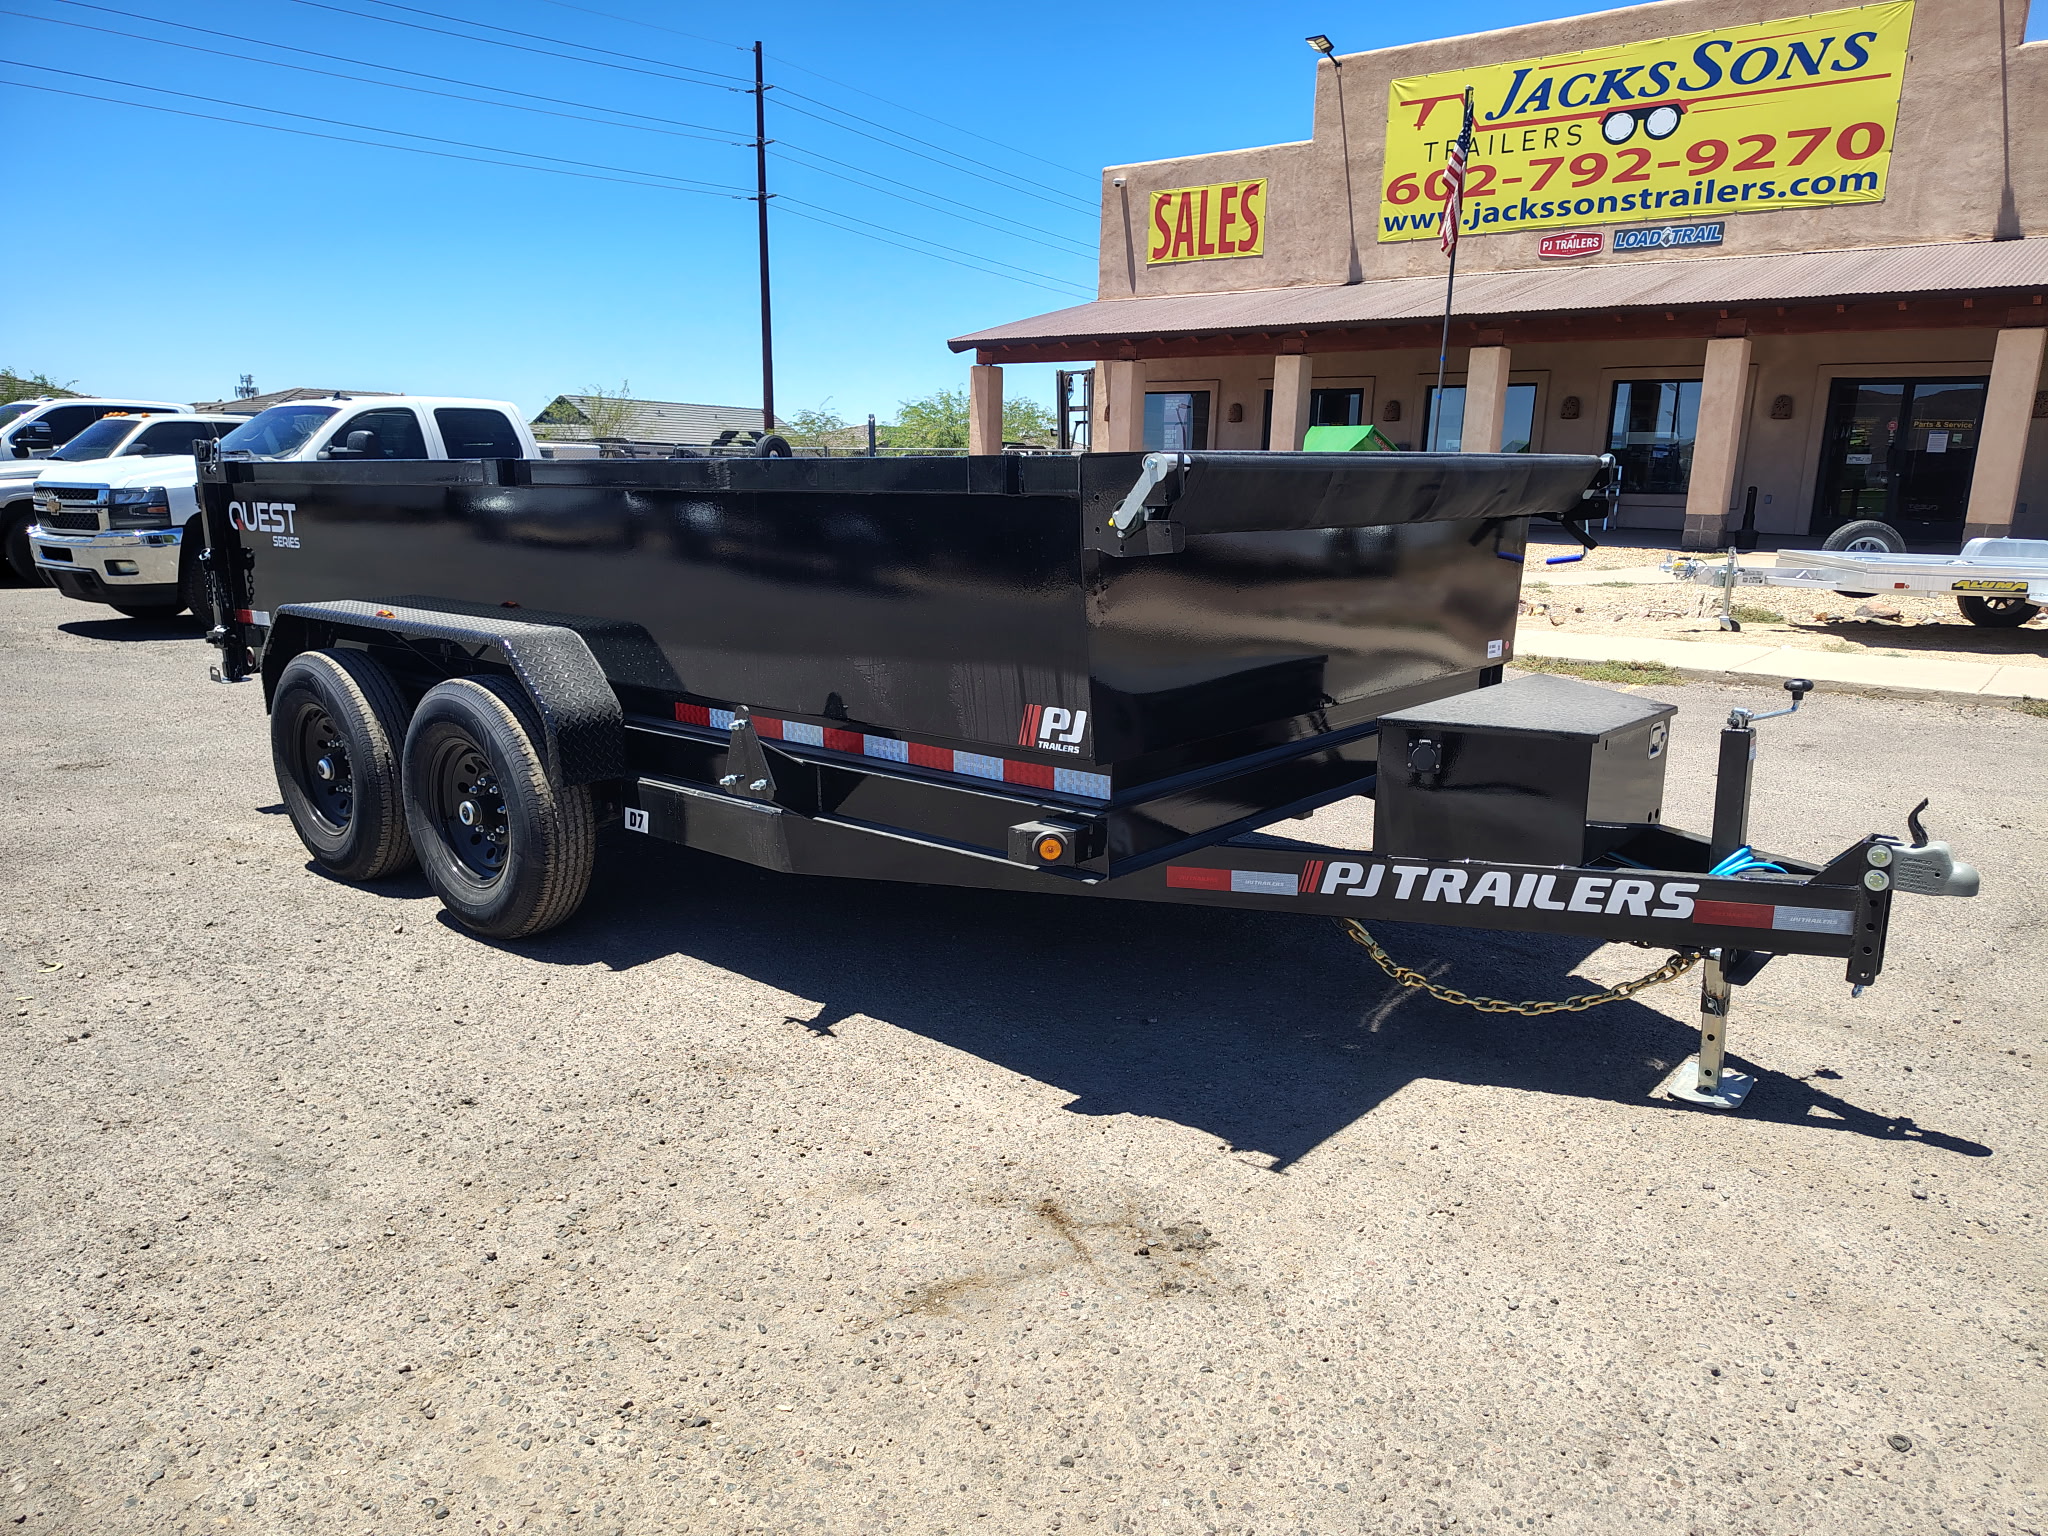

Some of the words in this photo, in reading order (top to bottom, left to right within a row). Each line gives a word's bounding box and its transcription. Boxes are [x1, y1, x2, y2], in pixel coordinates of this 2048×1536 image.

[1424, 124, 1583, 162] TRAILERS
[1386, 122, 1886, 205] 602-792-9270
[1152, 183, 1260, 260] SALES
[1542, 240, 1552, 251] PJ
[1555, 237, 1600, 250] TRAILERS
[1614, 230, 1662, 250] LOAD
[1671, 224, 1723, 244] TRAIL
[228, 501, 297, 534] QUEST
[272, 535, 301, 549] SERIES
[1953, 580, 2029, 592] ALUMA
[1040, 706, 1088, 744] PJ
[1038, 740, 1080, 754] TRAILERS
[630, 811, 644, 829] D7
[1320, 861, 1386, 898] PJ
[1392, 864, 1700, 920] TRAILERS
